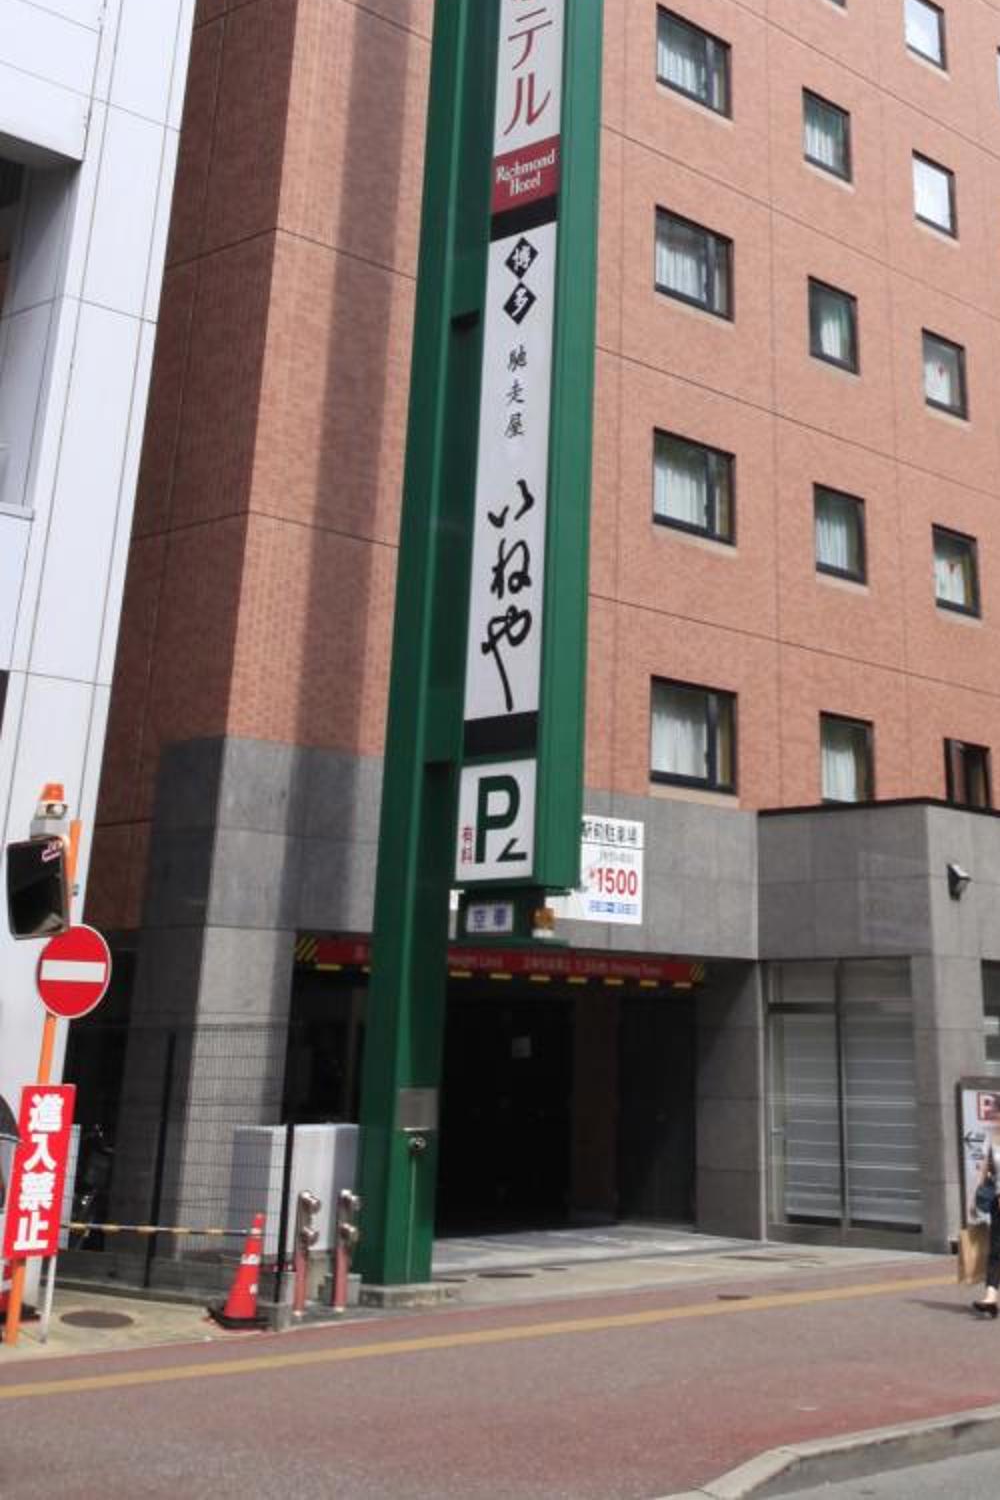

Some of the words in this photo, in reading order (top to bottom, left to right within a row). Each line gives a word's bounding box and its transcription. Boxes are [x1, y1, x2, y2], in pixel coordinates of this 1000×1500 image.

[495, 148, 555, 184] Richmond
[509, 172, 541, 197] Hotel
[474, 775, 521, 864] P
[13, 1093, 65, 1251] 進入禁止
